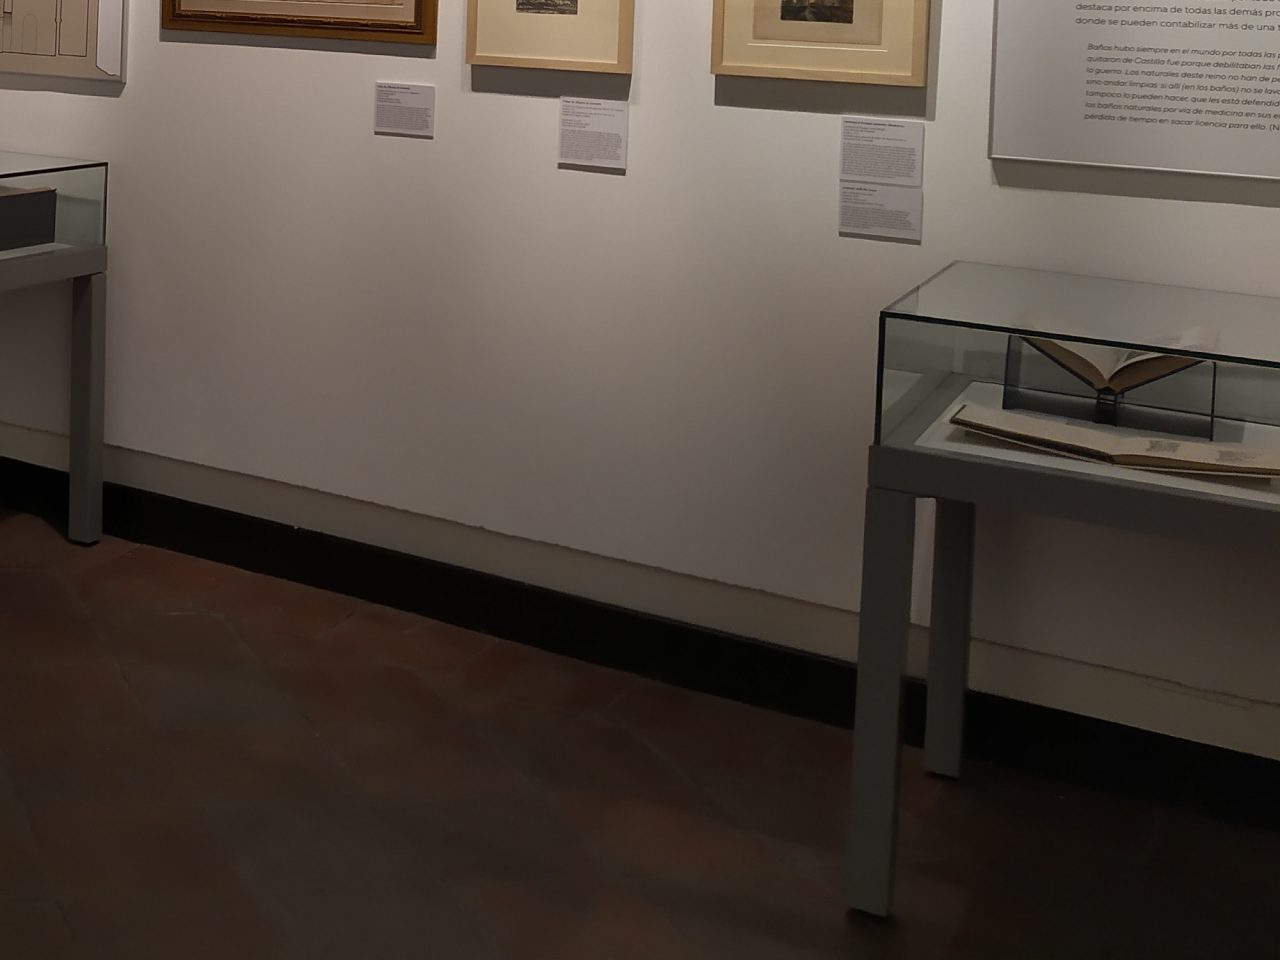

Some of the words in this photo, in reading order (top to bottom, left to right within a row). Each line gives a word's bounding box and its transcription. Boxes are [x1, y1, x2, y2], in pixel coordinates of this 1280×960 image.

[1075, 2, 1113, 12] destaca
[1133, 4, 1168, 13] encima
[1185, 5, 1211, 15] todas
[1229, 7, 1263, 16] demás
[1075, 16, 1106, 25] donde
[1121, 17, 1158, 29] pueden
[1160, 19, 1216, 29] contabilizar
[1191, 47, 1221, 56] mundo
[1239, 49, 1262, 58] todas
[1181, 60, 1212, 70] porque
[1228, 122, 1249, 131] para
